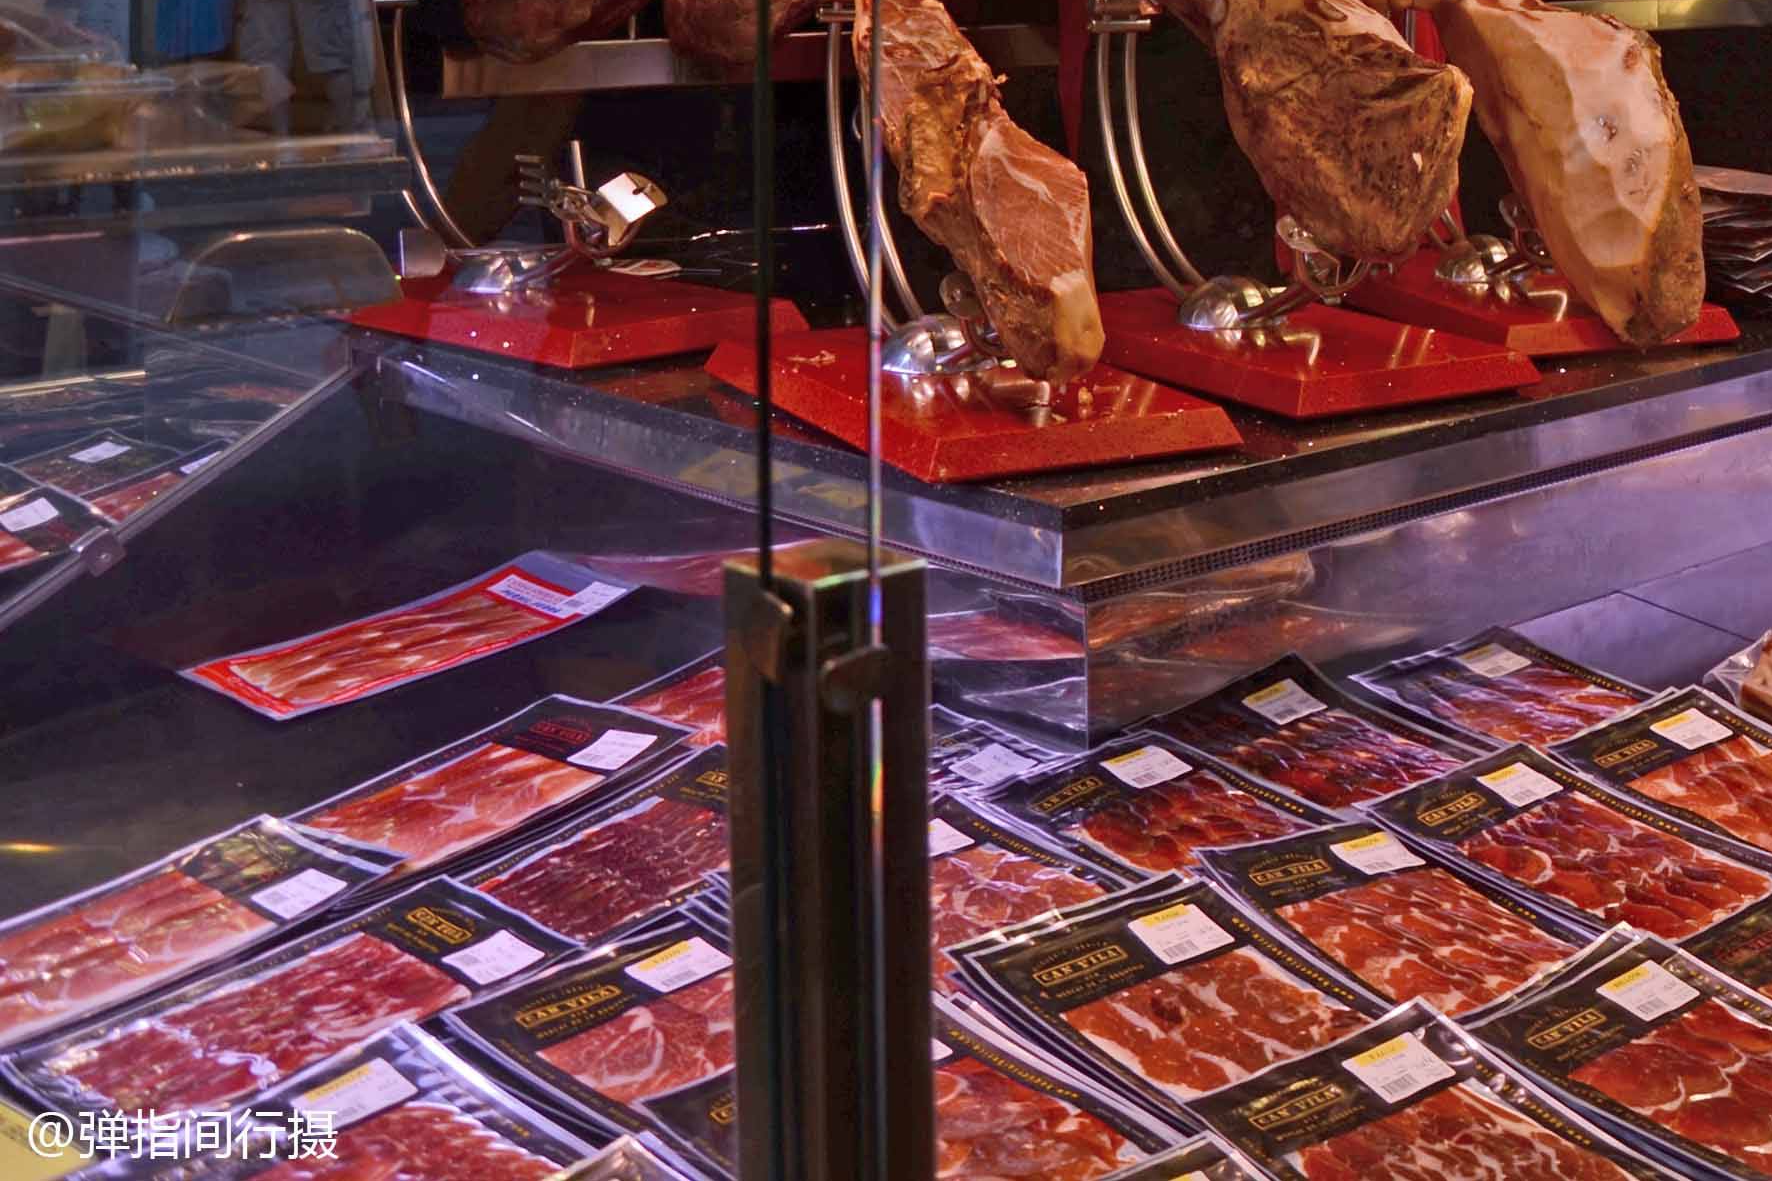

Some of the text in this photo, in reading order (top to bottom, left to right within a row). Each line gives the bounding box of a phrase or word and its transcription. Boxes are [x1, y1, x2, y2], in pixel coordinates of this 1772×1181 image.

[1288, 861, 1324, 878] VILA
[1040, 966, 1074, 983] CAN
[1077, 949, 1118, 971] VILA
[564, 987, 614, 1009] VILA
[1295, 1089, 1340, 1112] VILA
